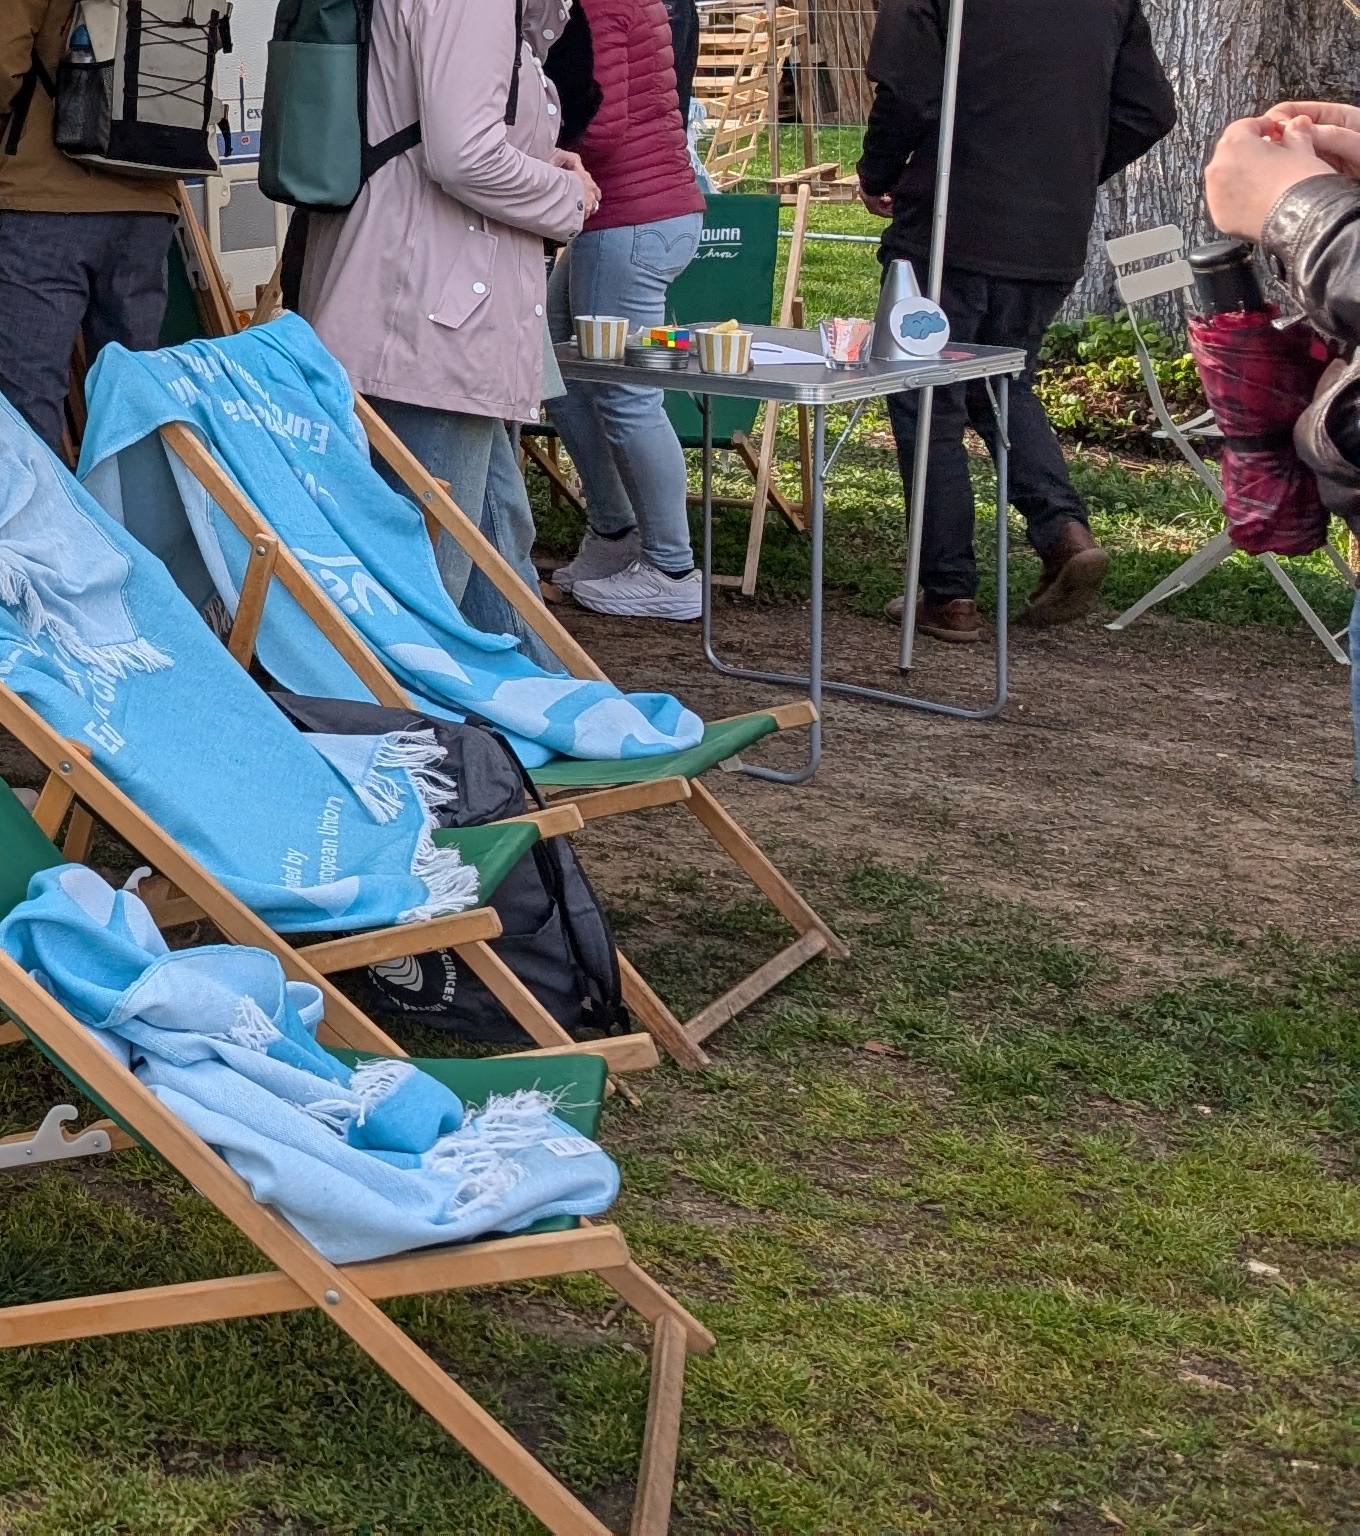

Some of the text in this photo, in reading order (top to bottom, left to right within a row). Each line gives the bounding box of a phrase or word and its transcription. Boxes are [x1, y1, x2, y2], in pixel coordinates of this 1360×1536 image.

[282, 847, 309, 866] by
[316, 795, 344, 885] uropean Union
